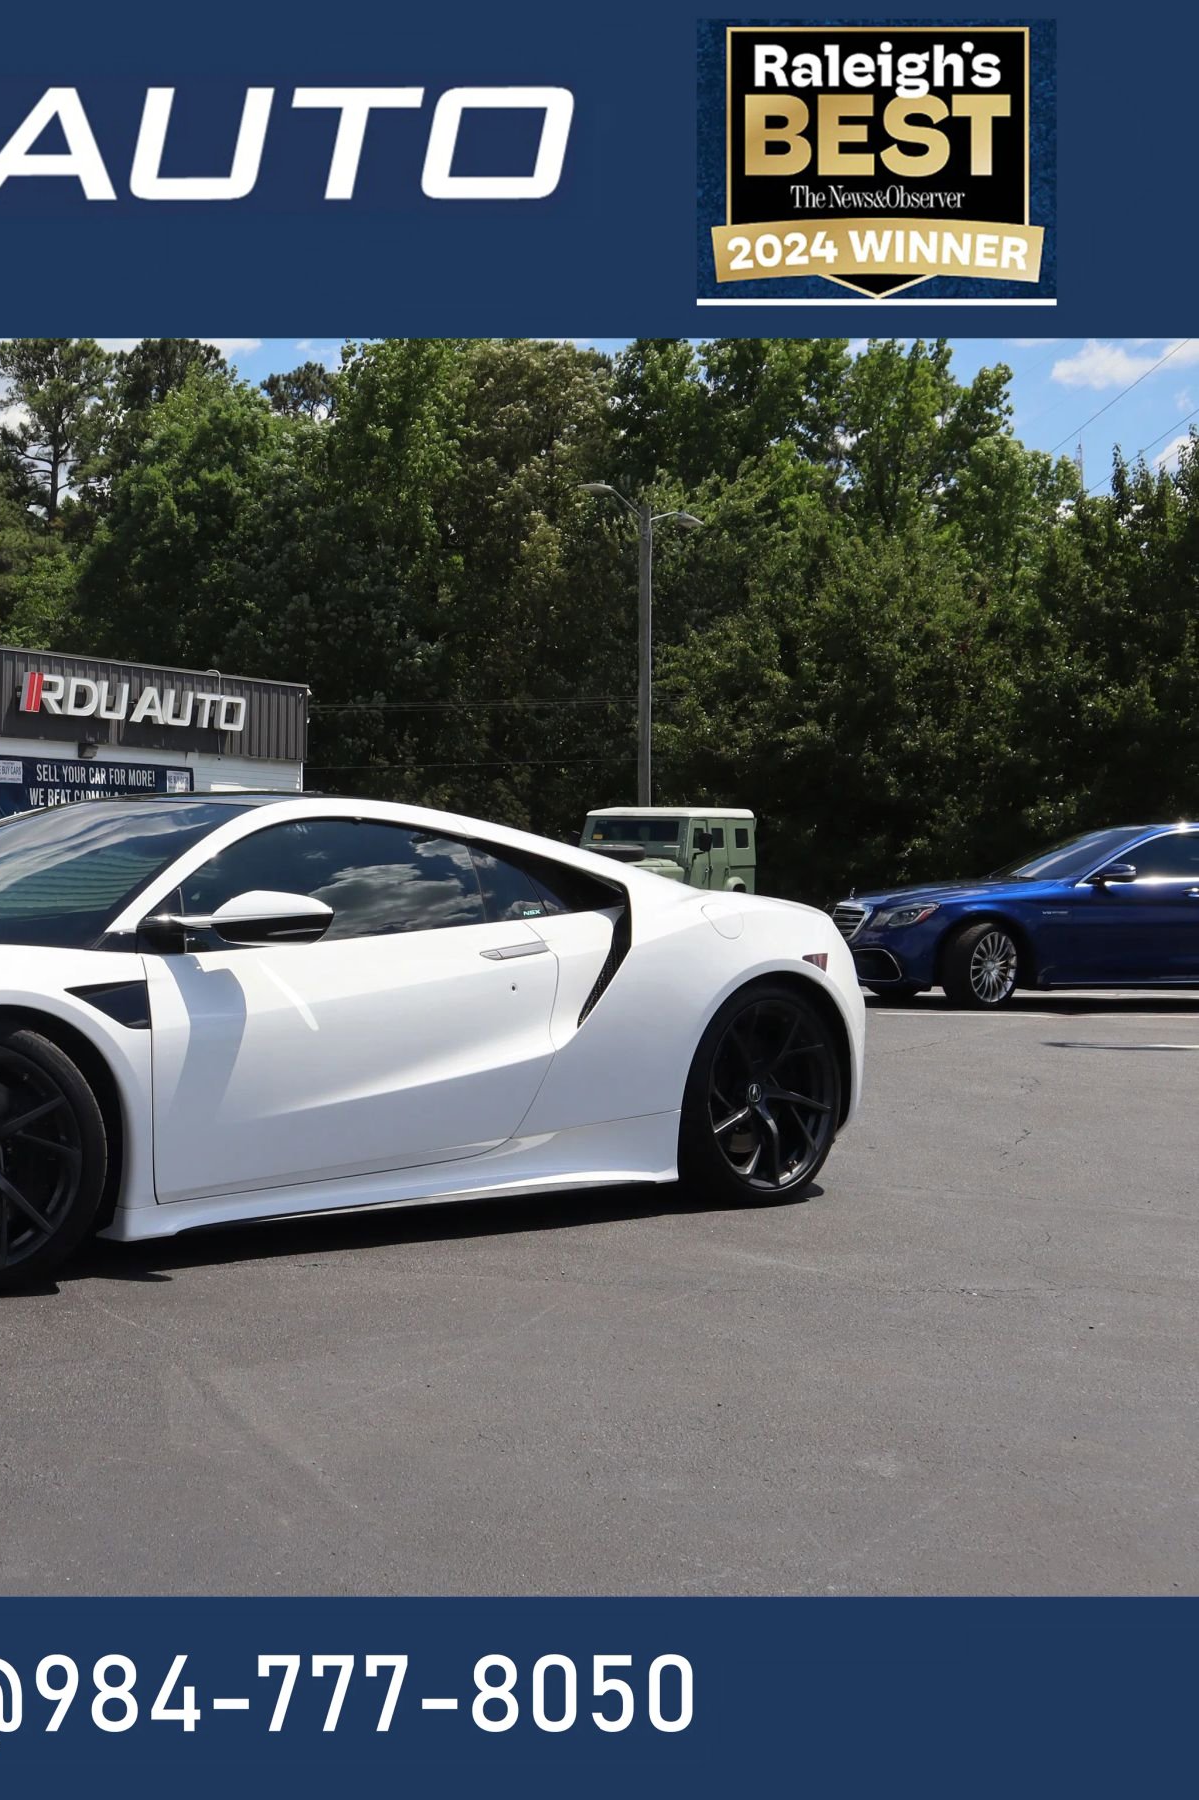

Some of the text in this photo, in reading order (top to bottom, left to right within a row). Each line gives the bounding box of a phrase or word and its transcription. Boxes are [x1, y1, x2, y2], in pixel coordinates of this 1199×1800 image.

[40, 674, 246, 732] RDU AUTO
[36, 763, 60, 783] SELL
[62, 764, 87, 784] YOUR
[89, 766, 106, 785] CAR
[109, 768, 126, 786] FOR
[128, 768, 156, 787] MORE!
[29, 787, 45, 806] WE
[48, 788, 71, 806] BEAT
